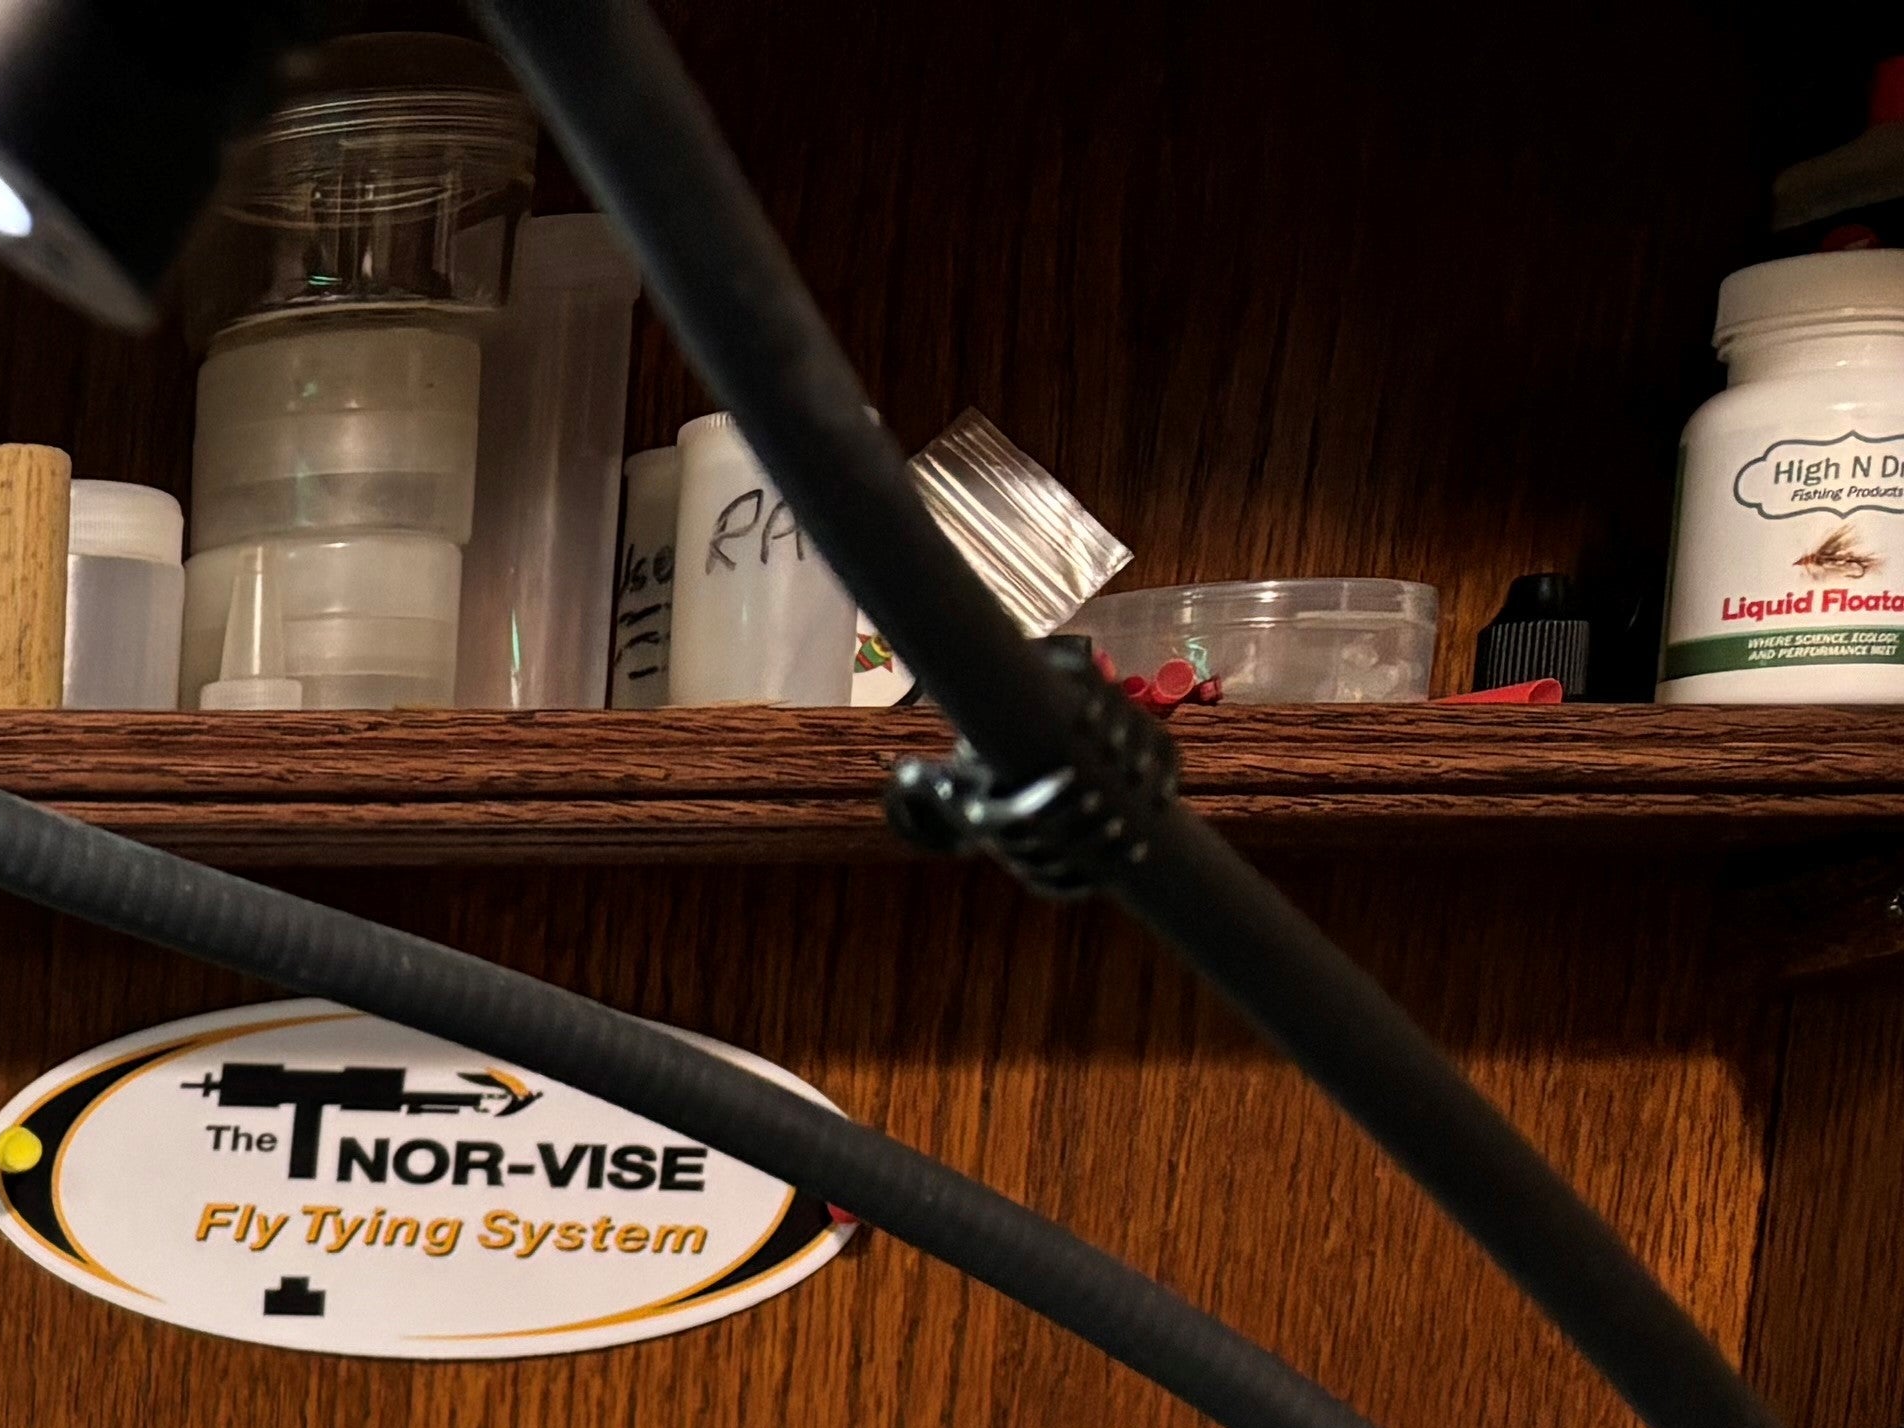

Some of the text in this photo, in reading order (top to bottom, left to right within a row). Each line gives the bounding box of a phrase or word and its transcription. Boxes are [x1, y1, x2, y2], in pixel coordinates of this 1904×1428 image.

[1774, 456, 1872, 486] High N
[1791, 485, 1904, 502] Fishing Products
[1721, 590, 1814, 622] Liquid
[206, 1125, 277, 1155] The
[194, 1203, 707, 1257] Fly Tying System
